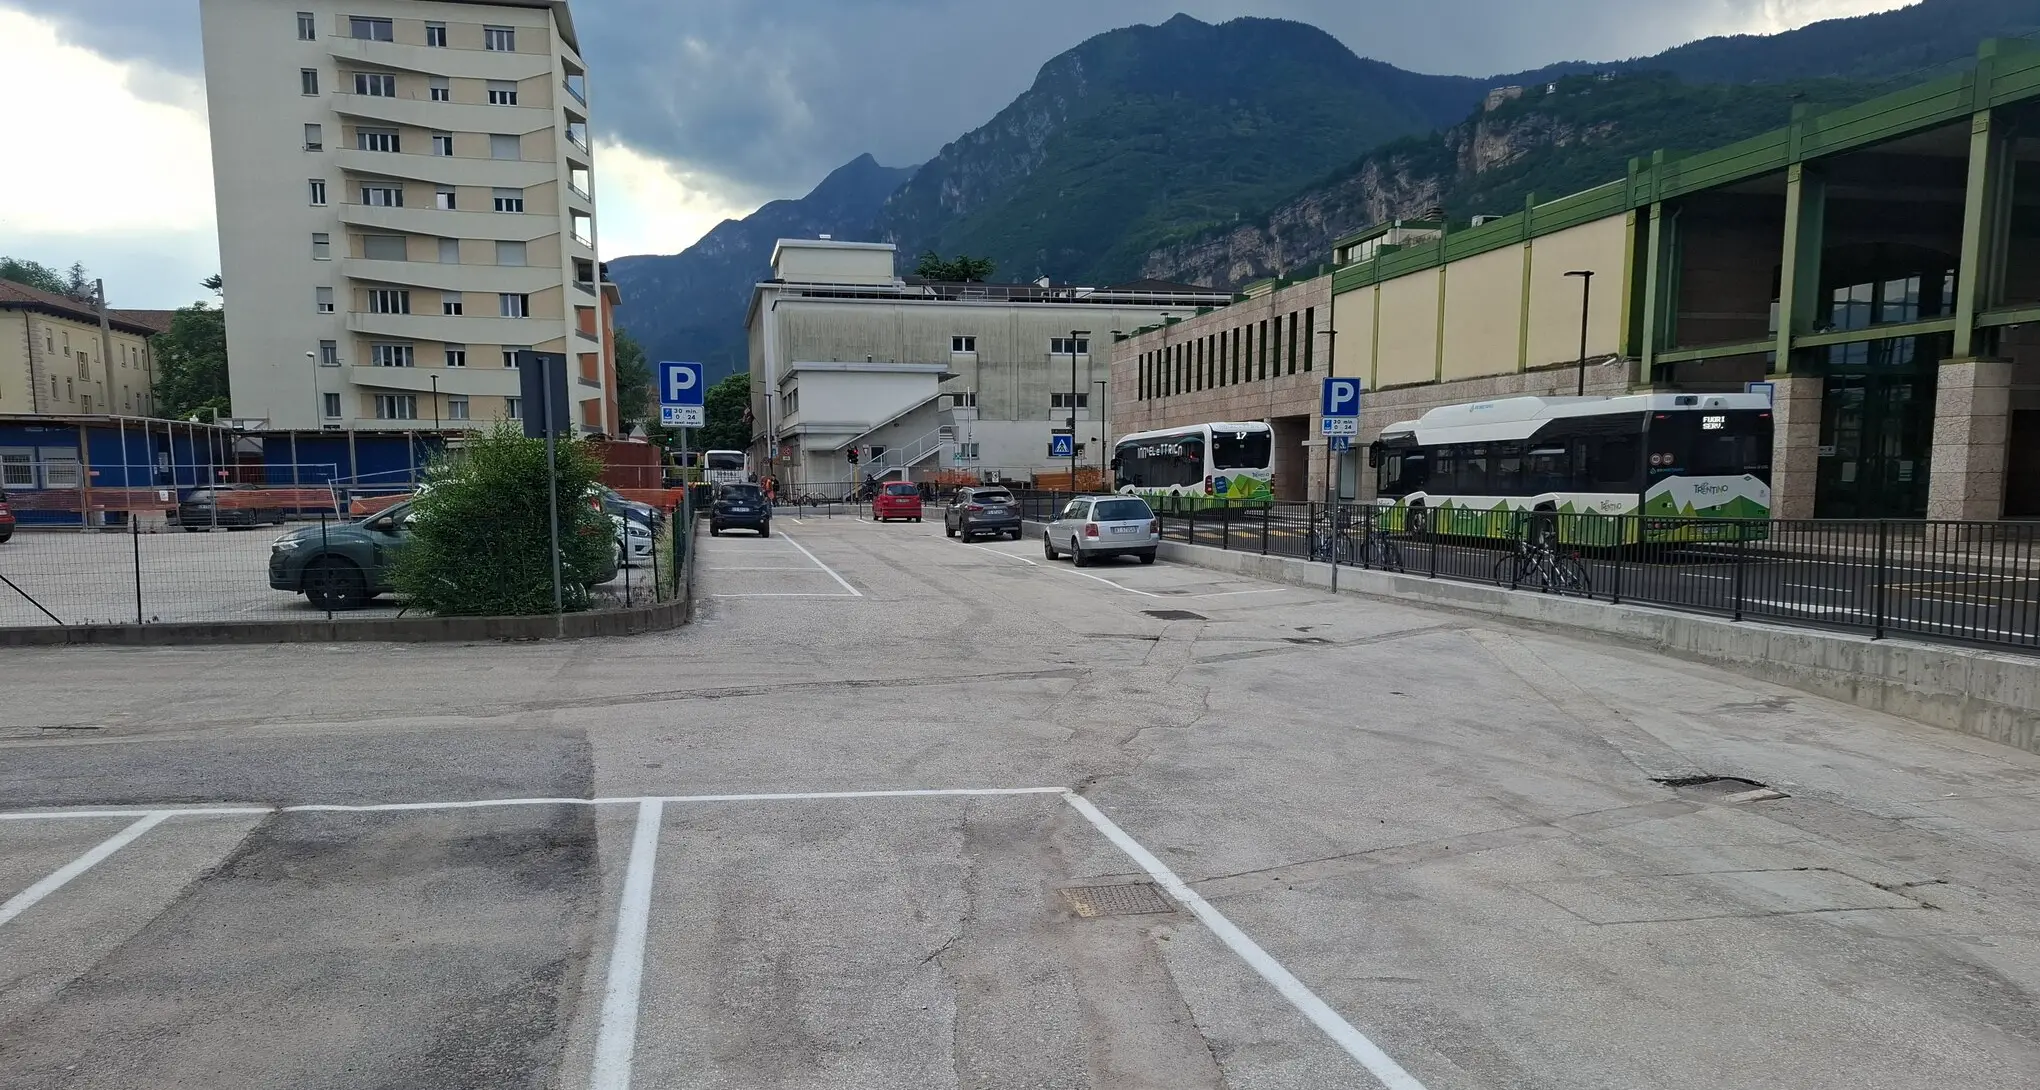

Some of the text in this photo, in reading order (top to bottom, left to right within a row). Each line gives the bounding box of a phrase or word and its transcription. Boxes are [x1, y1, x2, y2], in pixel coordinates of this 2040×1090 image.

[669, 366, 696, 400] P
[1331, 381, 1354, 412] P
[1236, 431, 1248, 440] 17
